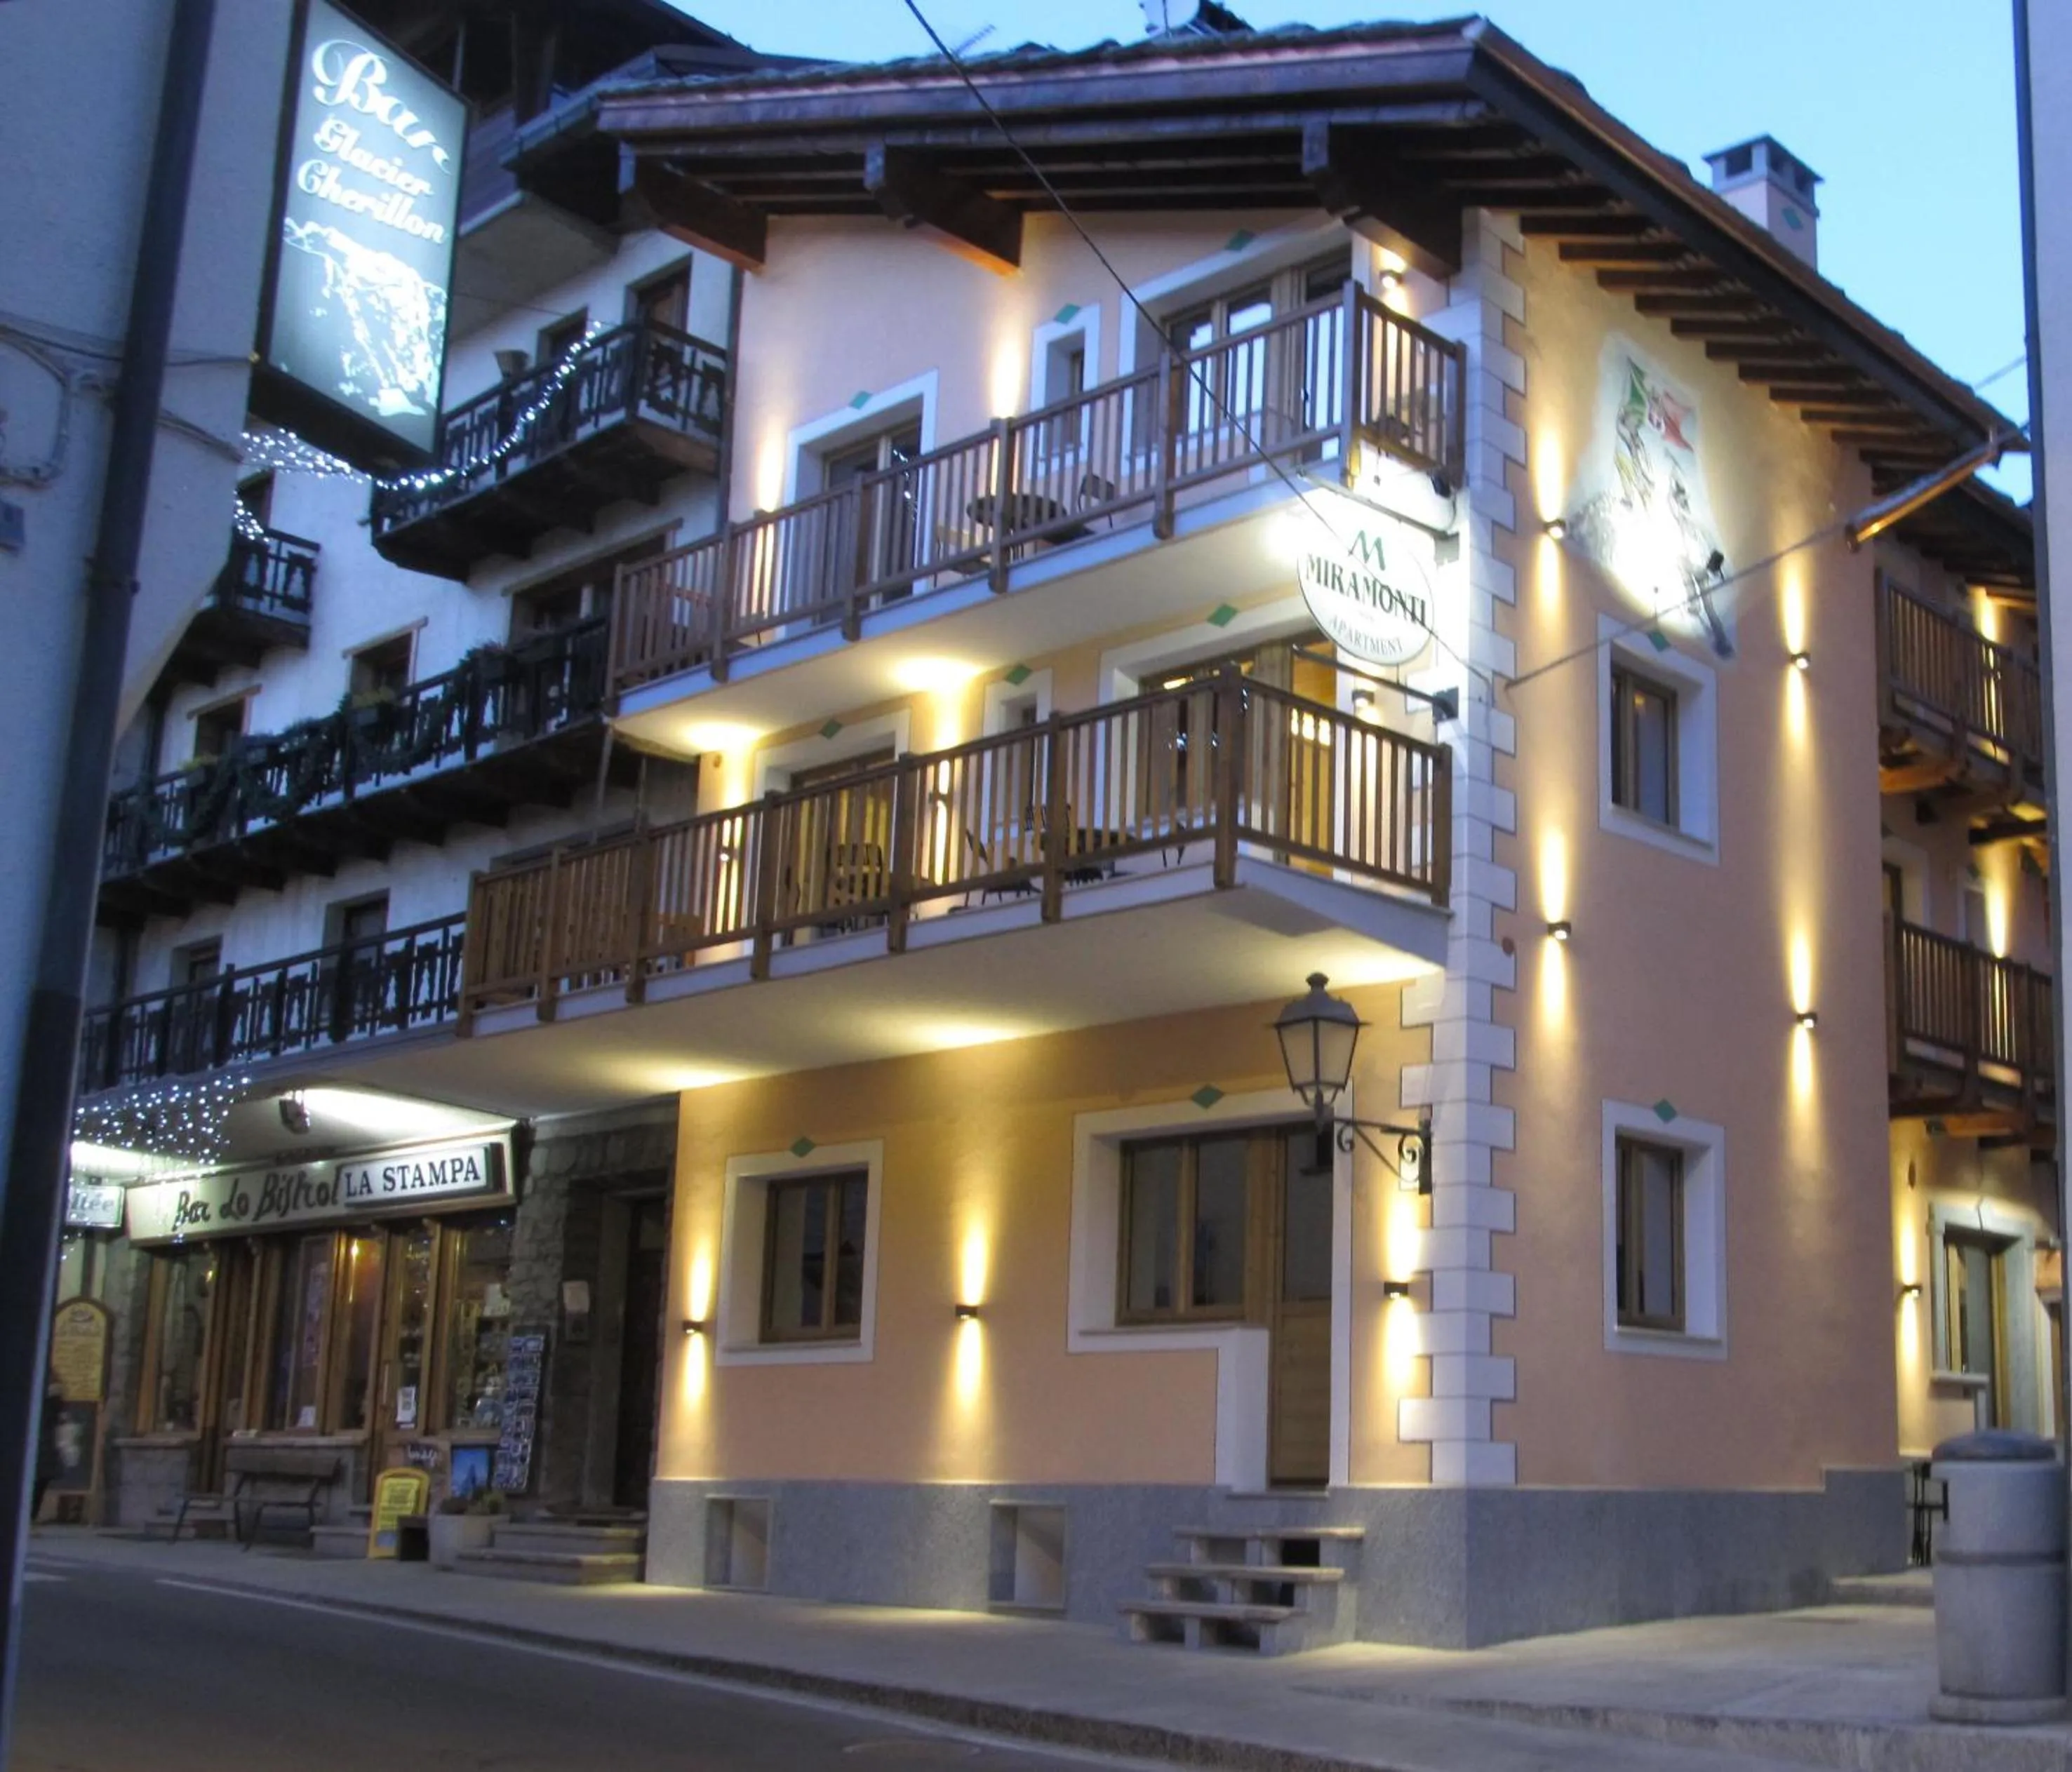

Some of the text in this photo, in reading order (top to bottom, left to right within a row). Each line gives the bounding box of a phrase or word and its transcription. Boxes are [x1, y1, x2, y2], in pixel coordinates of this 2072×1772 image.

[312, 39, 451, 175] Bar
[313, 112, 434, 196] Glacier
[1305, 552, 1426, 627] MIRAMONTI
[345, 1155, 481, 1197] LA STAMPA
